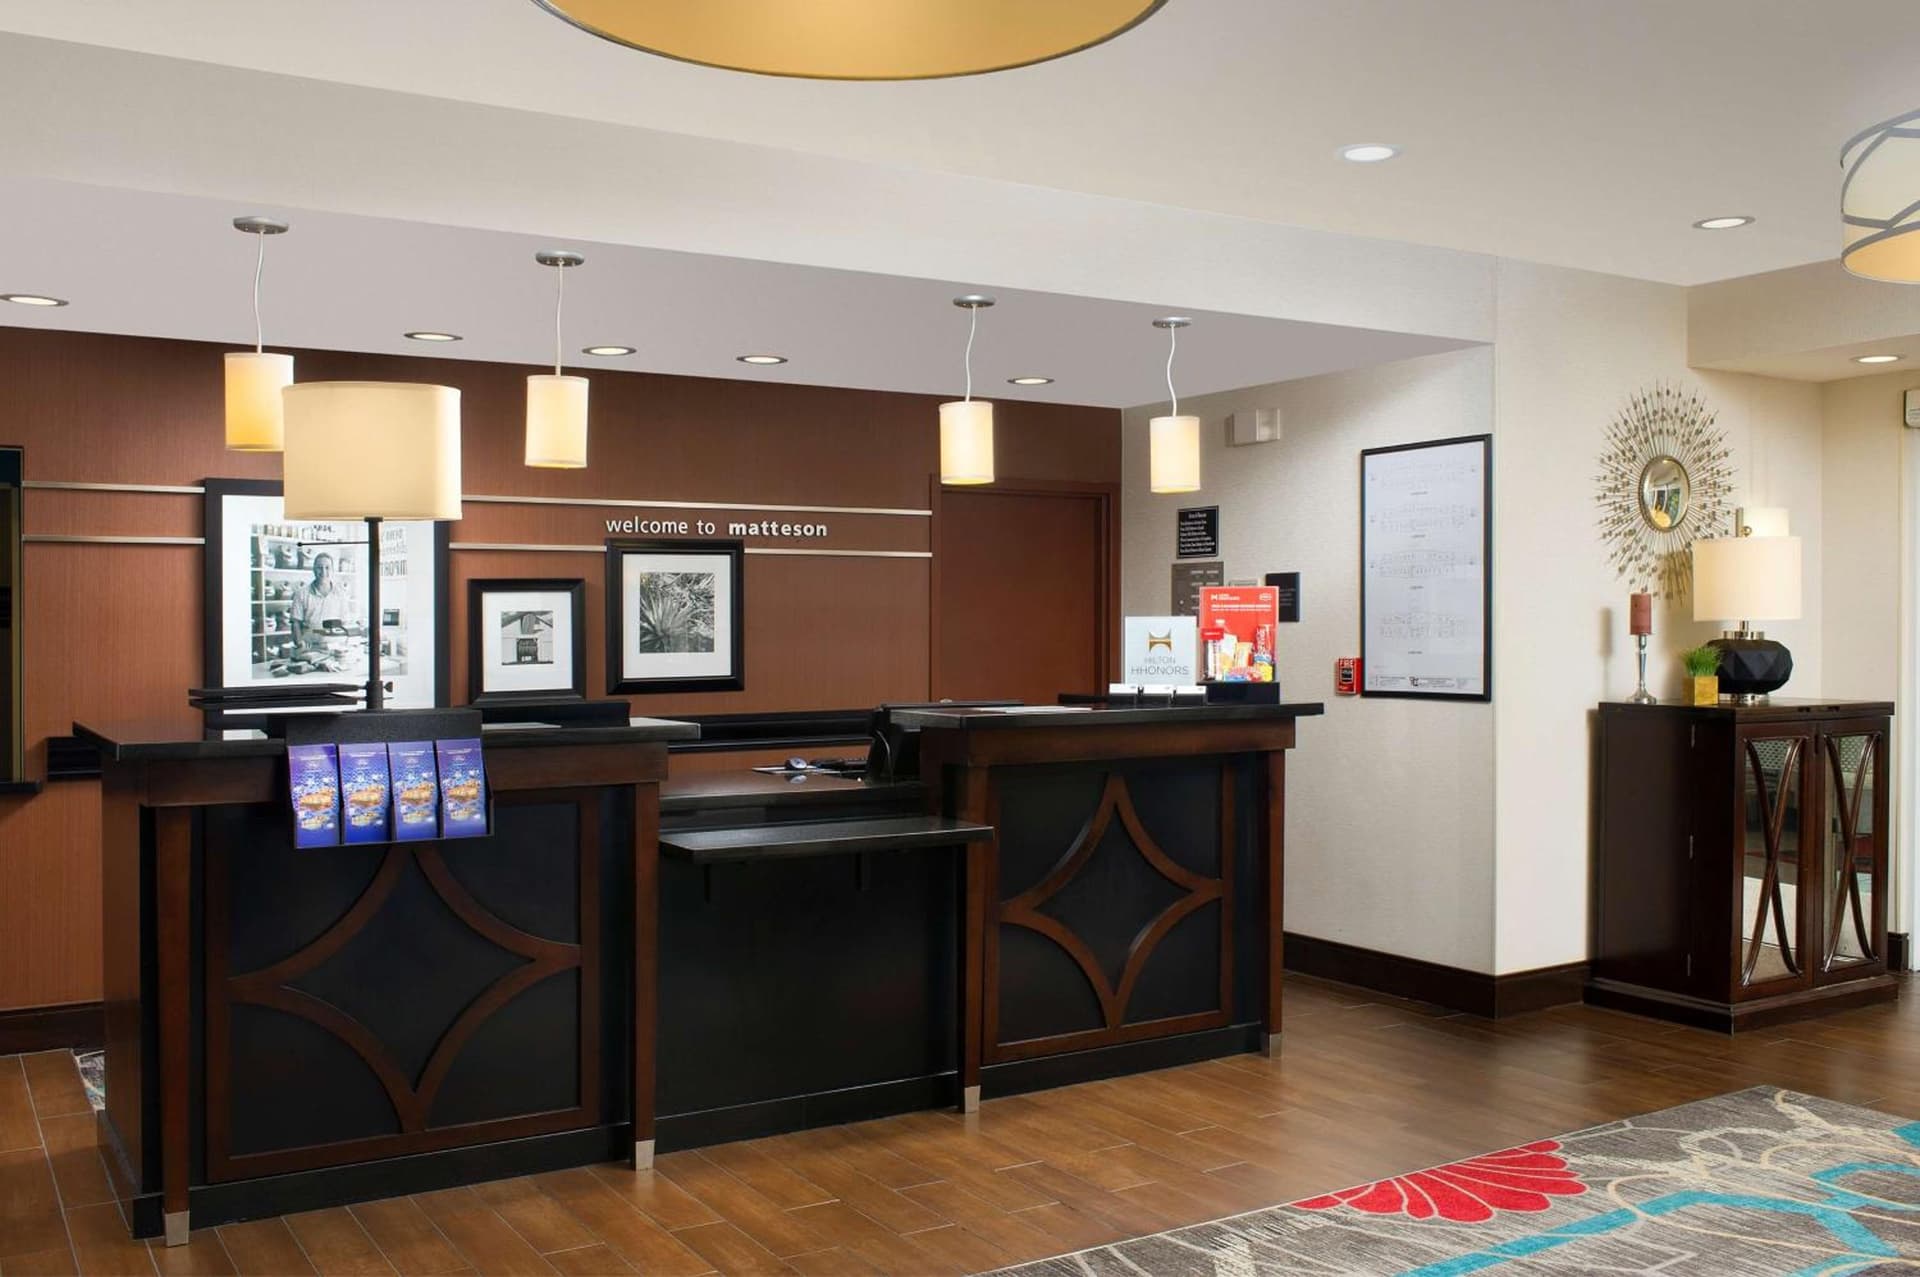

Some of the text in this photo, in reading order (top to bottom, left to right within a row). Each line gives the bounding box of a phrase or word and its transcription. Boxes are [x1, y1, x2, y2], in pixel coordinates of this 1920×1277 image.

[606, 516, 828, 538] welcome to matteson
[1144, 656, 1176, 664] HILTON
[1339, 658, 1354, 667] FIRE
[1131, 666, 1189, 675] HHONORS
